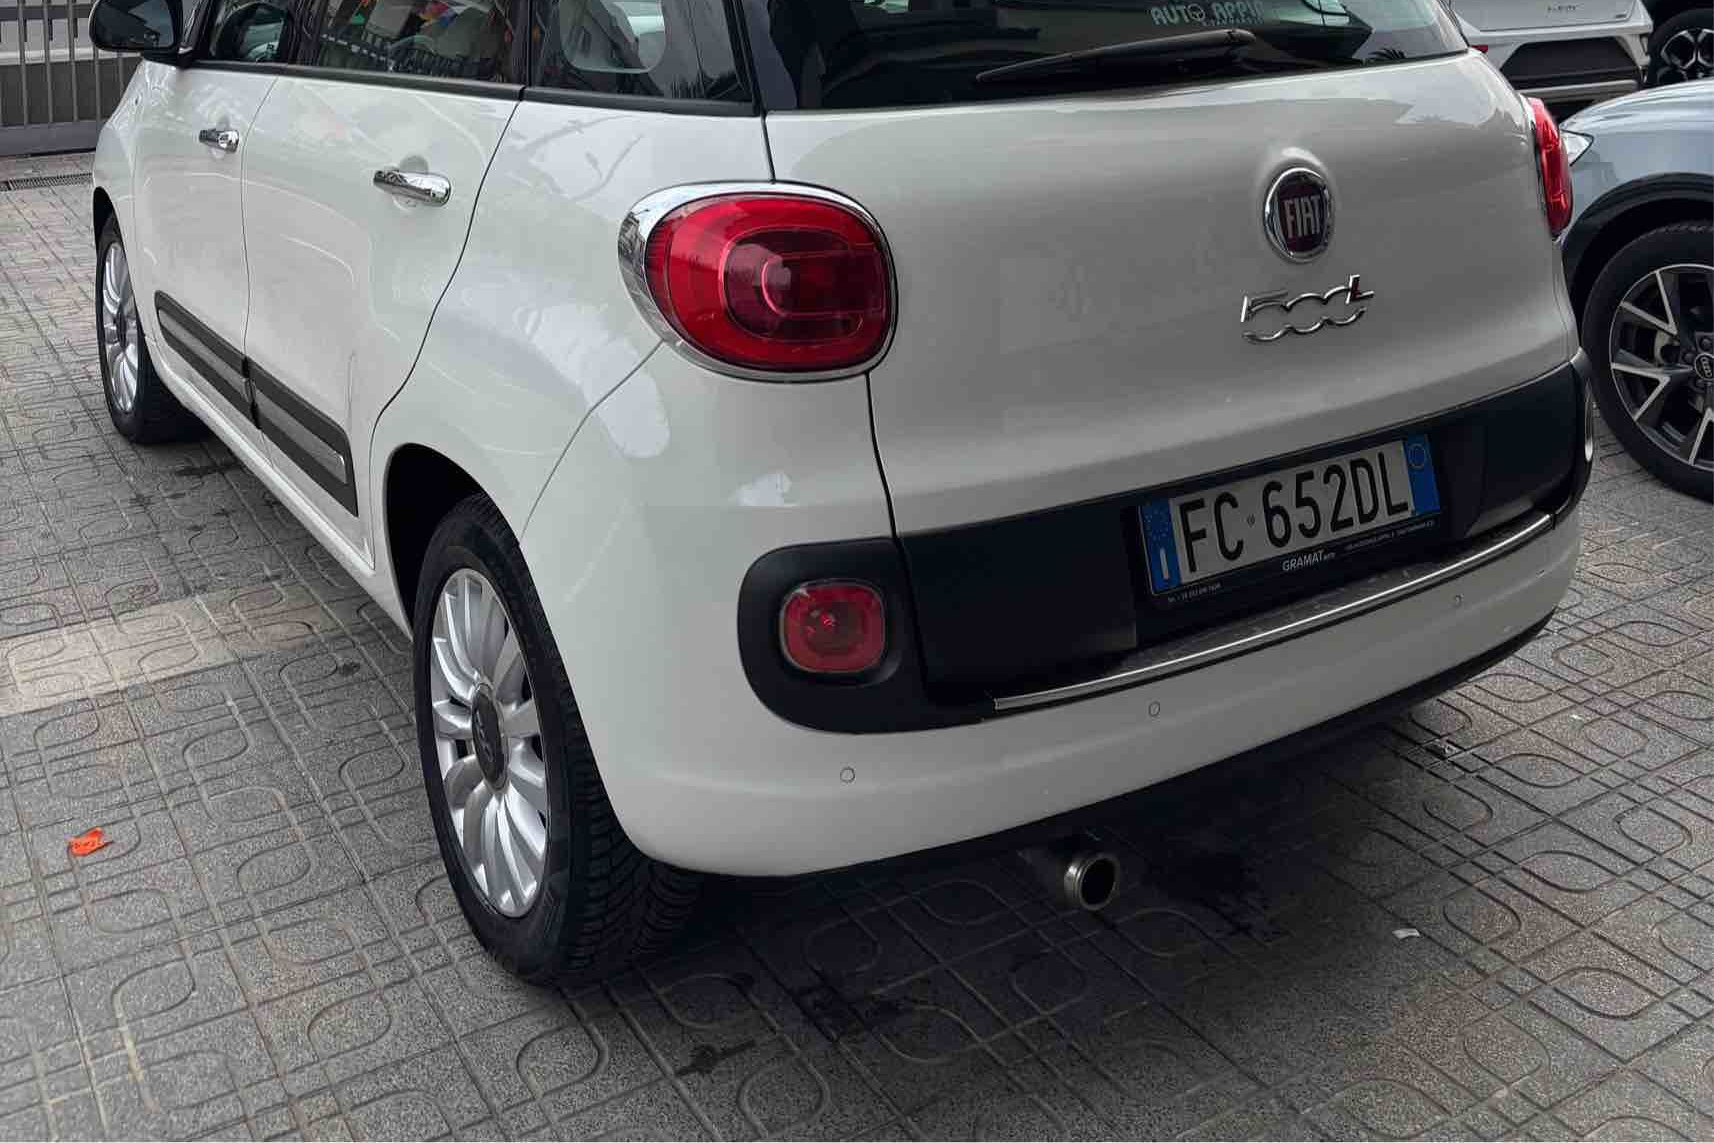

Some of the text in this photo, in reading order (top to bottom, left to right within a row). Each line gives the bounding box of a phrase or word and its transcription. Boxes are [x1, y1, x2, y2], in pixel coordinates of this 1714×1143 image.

[1284, 195, 1321, 239] FIAT
[1179, 491, 1244, 573] FC
[1262, 452, 1409, 548] 652DL
[1282, 548, 1326, 572] GRAMAT
